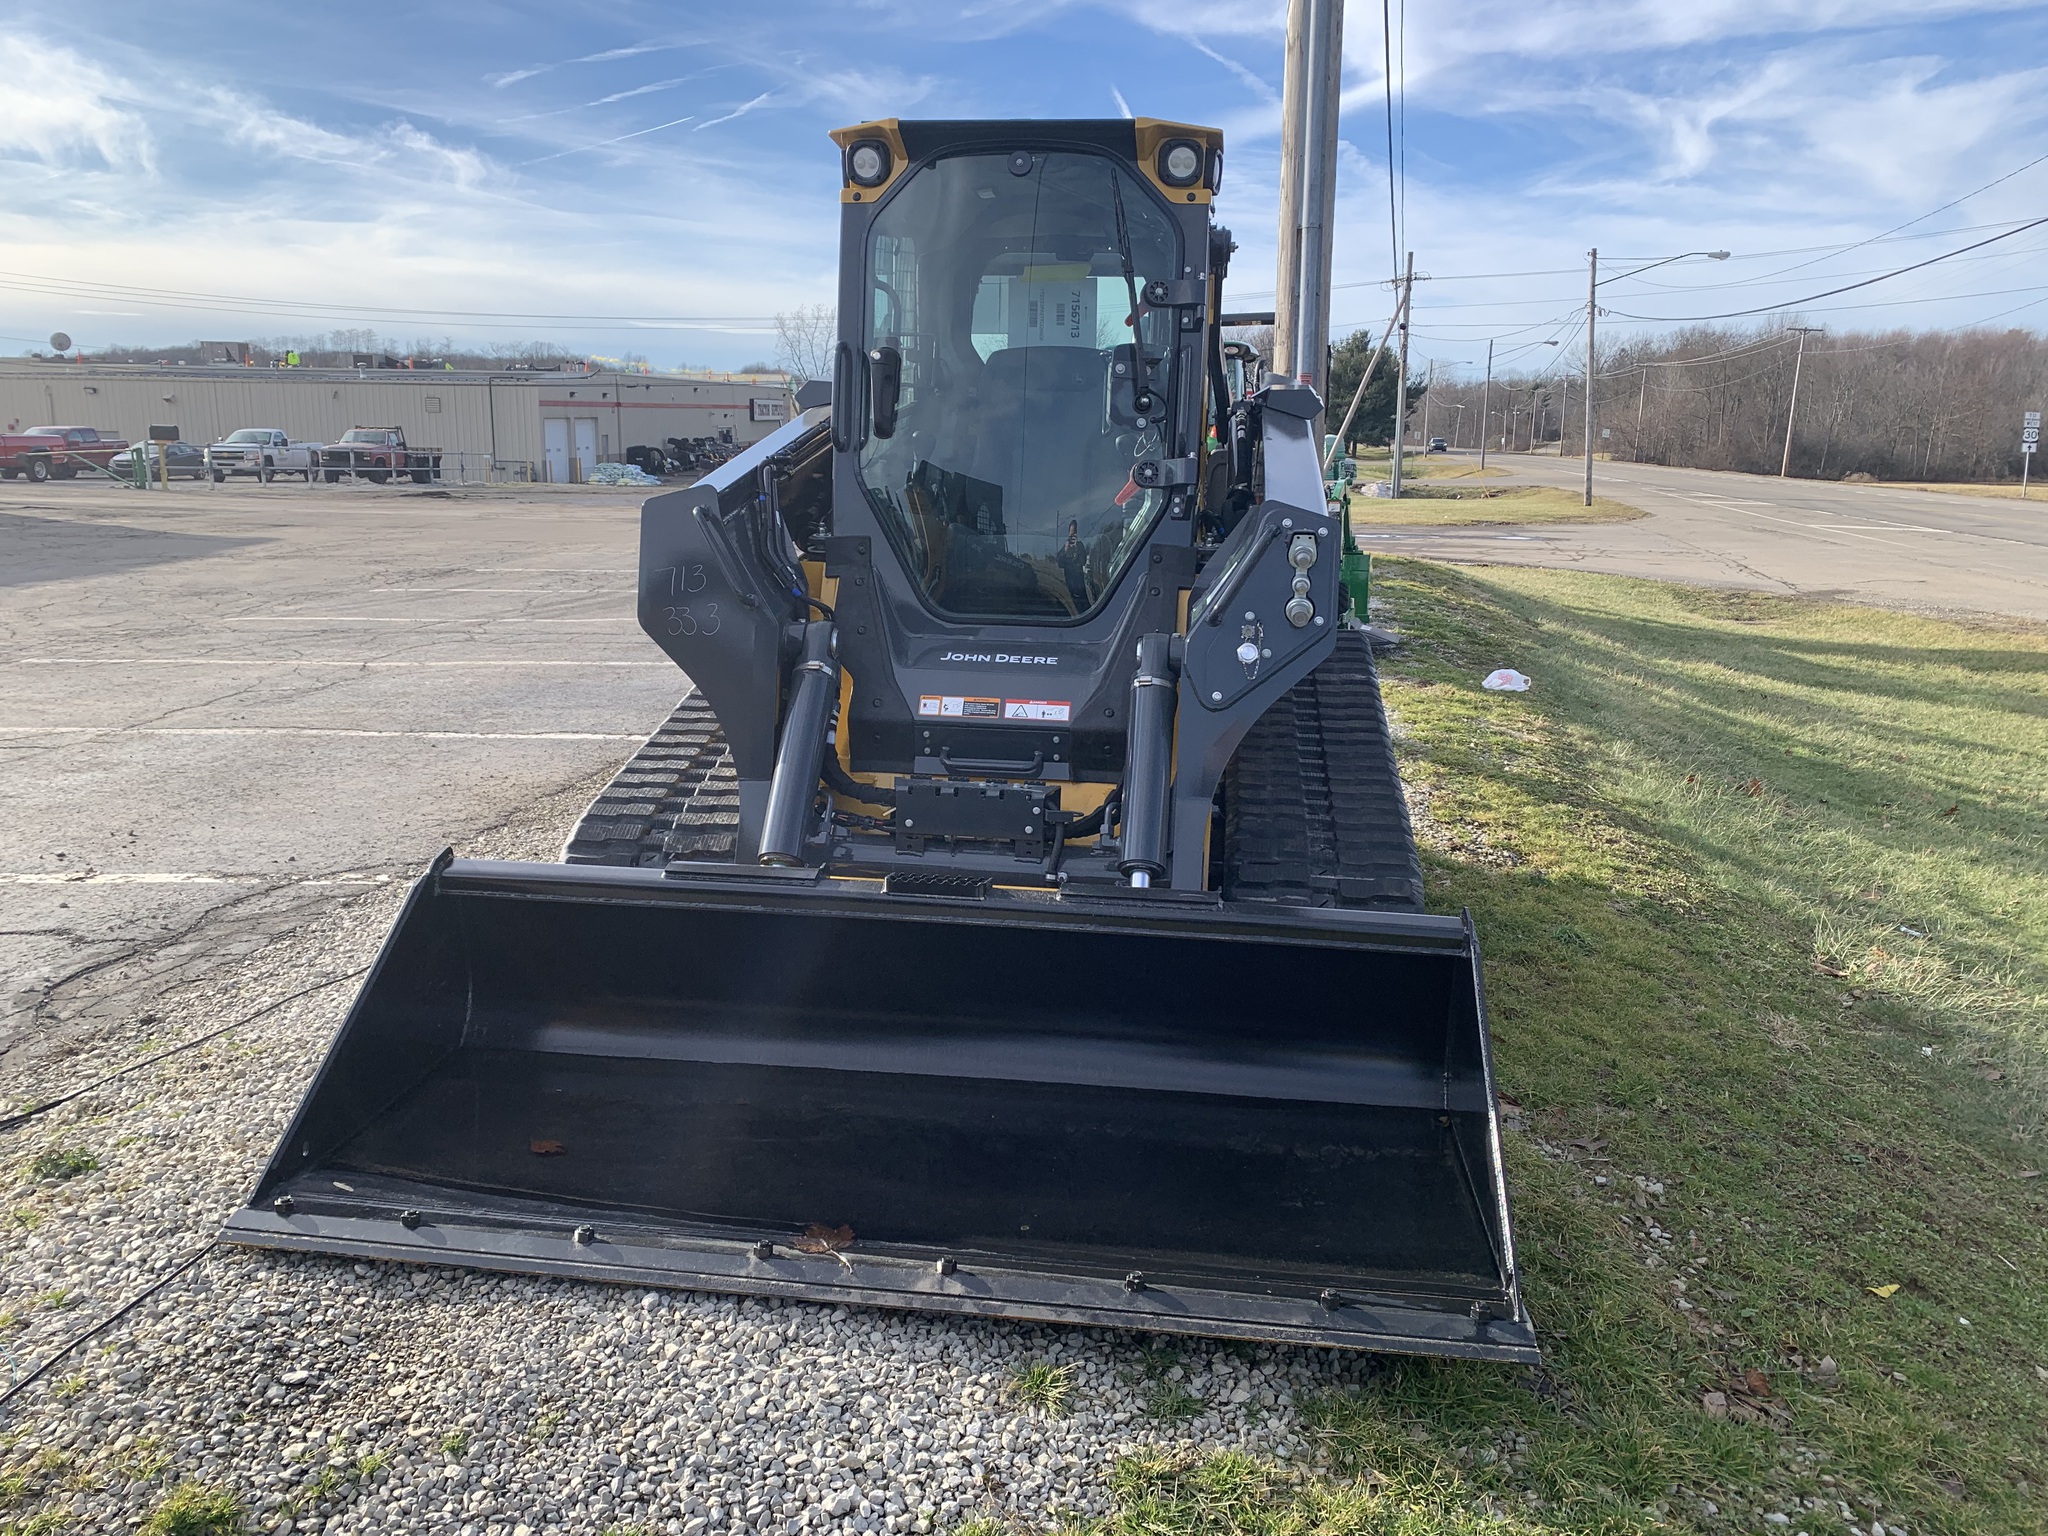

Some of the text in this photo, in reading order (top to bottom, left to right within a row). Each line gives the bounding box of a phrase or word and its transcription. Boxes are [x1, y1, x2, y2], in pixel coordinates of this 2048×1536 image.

[1071, 291, 1081, 339] 7156713
[2024, 430, 2037, 439] 30
[653, 564, 707, 597] 713
[940, 652, 1058, 665] JOHN DEERE
